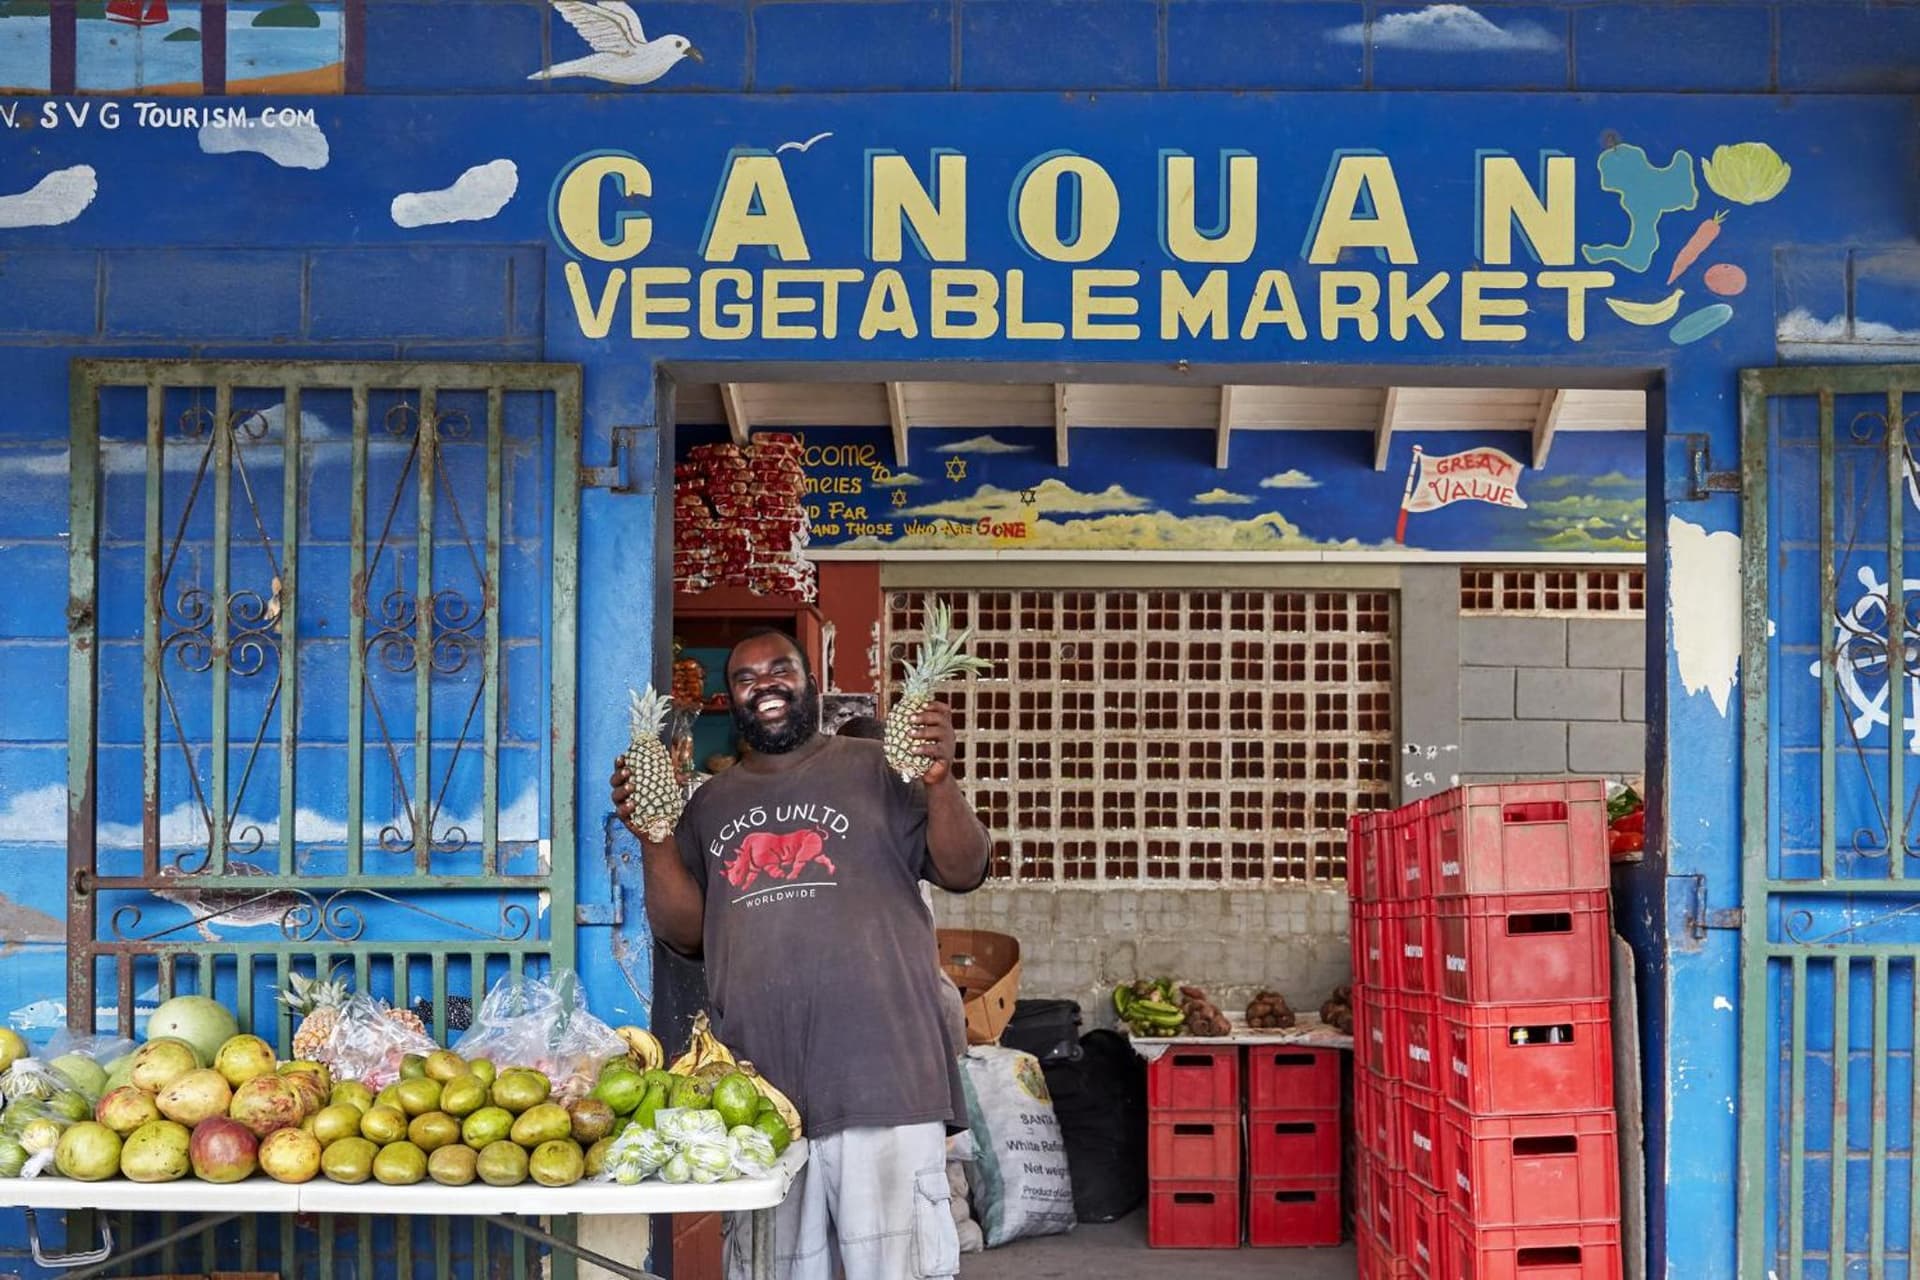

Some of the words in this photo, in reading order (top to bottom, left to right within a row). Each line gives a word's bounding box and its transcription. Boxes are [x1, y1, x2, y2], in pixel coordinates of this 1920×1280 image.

[548, 148, 1576, 265] CANOUAN
[564, 261, 1141, 340] VEGETABLE
[1160, 269, 1616, 342] MARKET
[1436, 453, 1513, 477] GREAT
[1428, 477, 1514, 506] VALUE
[811, 524, 841, 537] AND
[845, 522, 894, 536] THOSE
[745, 888, 816, 908] WORLDWIDE
[1006, 1140, 1041, 1152] White
[1023, 1161, 1043, 1175] Net
